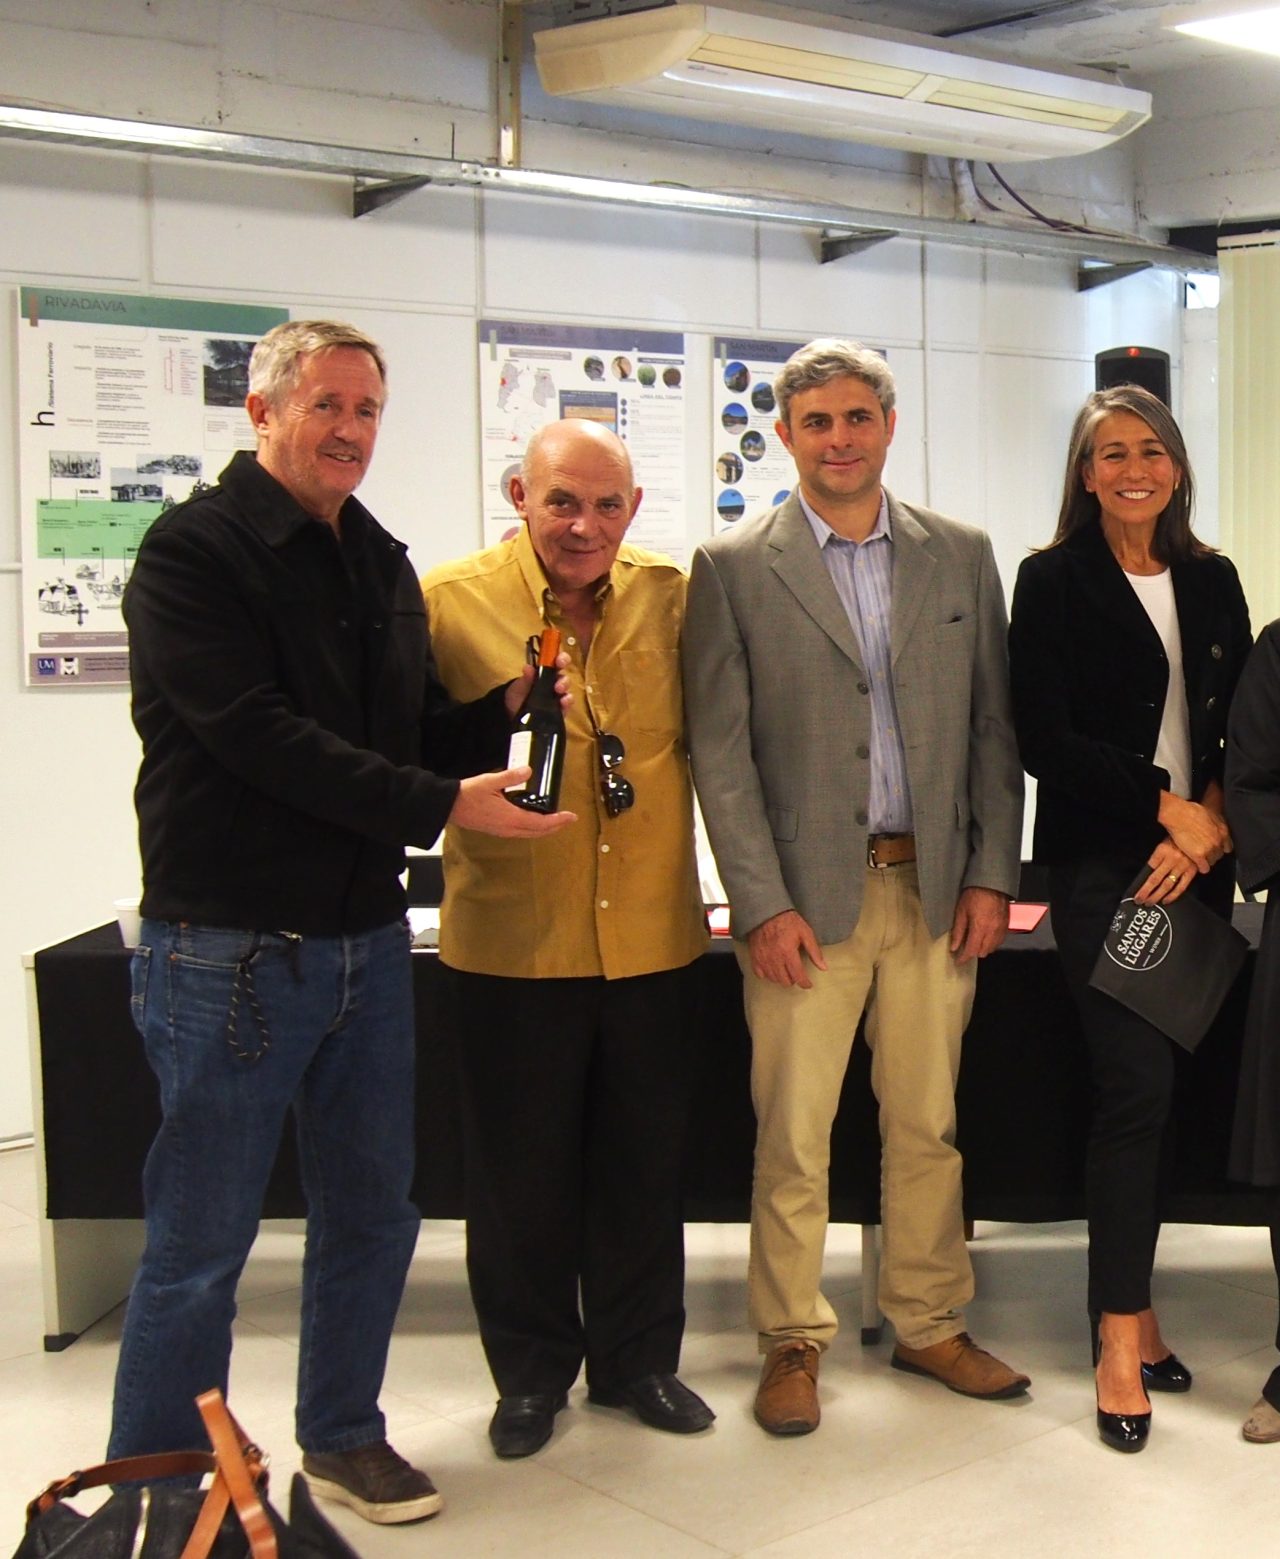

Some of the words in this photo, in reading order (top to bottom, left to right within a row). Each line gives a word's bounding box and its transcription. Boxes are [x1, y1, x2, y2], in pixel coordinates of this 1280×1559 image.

[45, 295, 127, 312] RIVADAVIA
[31, 410, 55, 426] h
[1117, 908, 1148, 954] SANTOS
[1125, 911, 1162, 965] LUGARES
